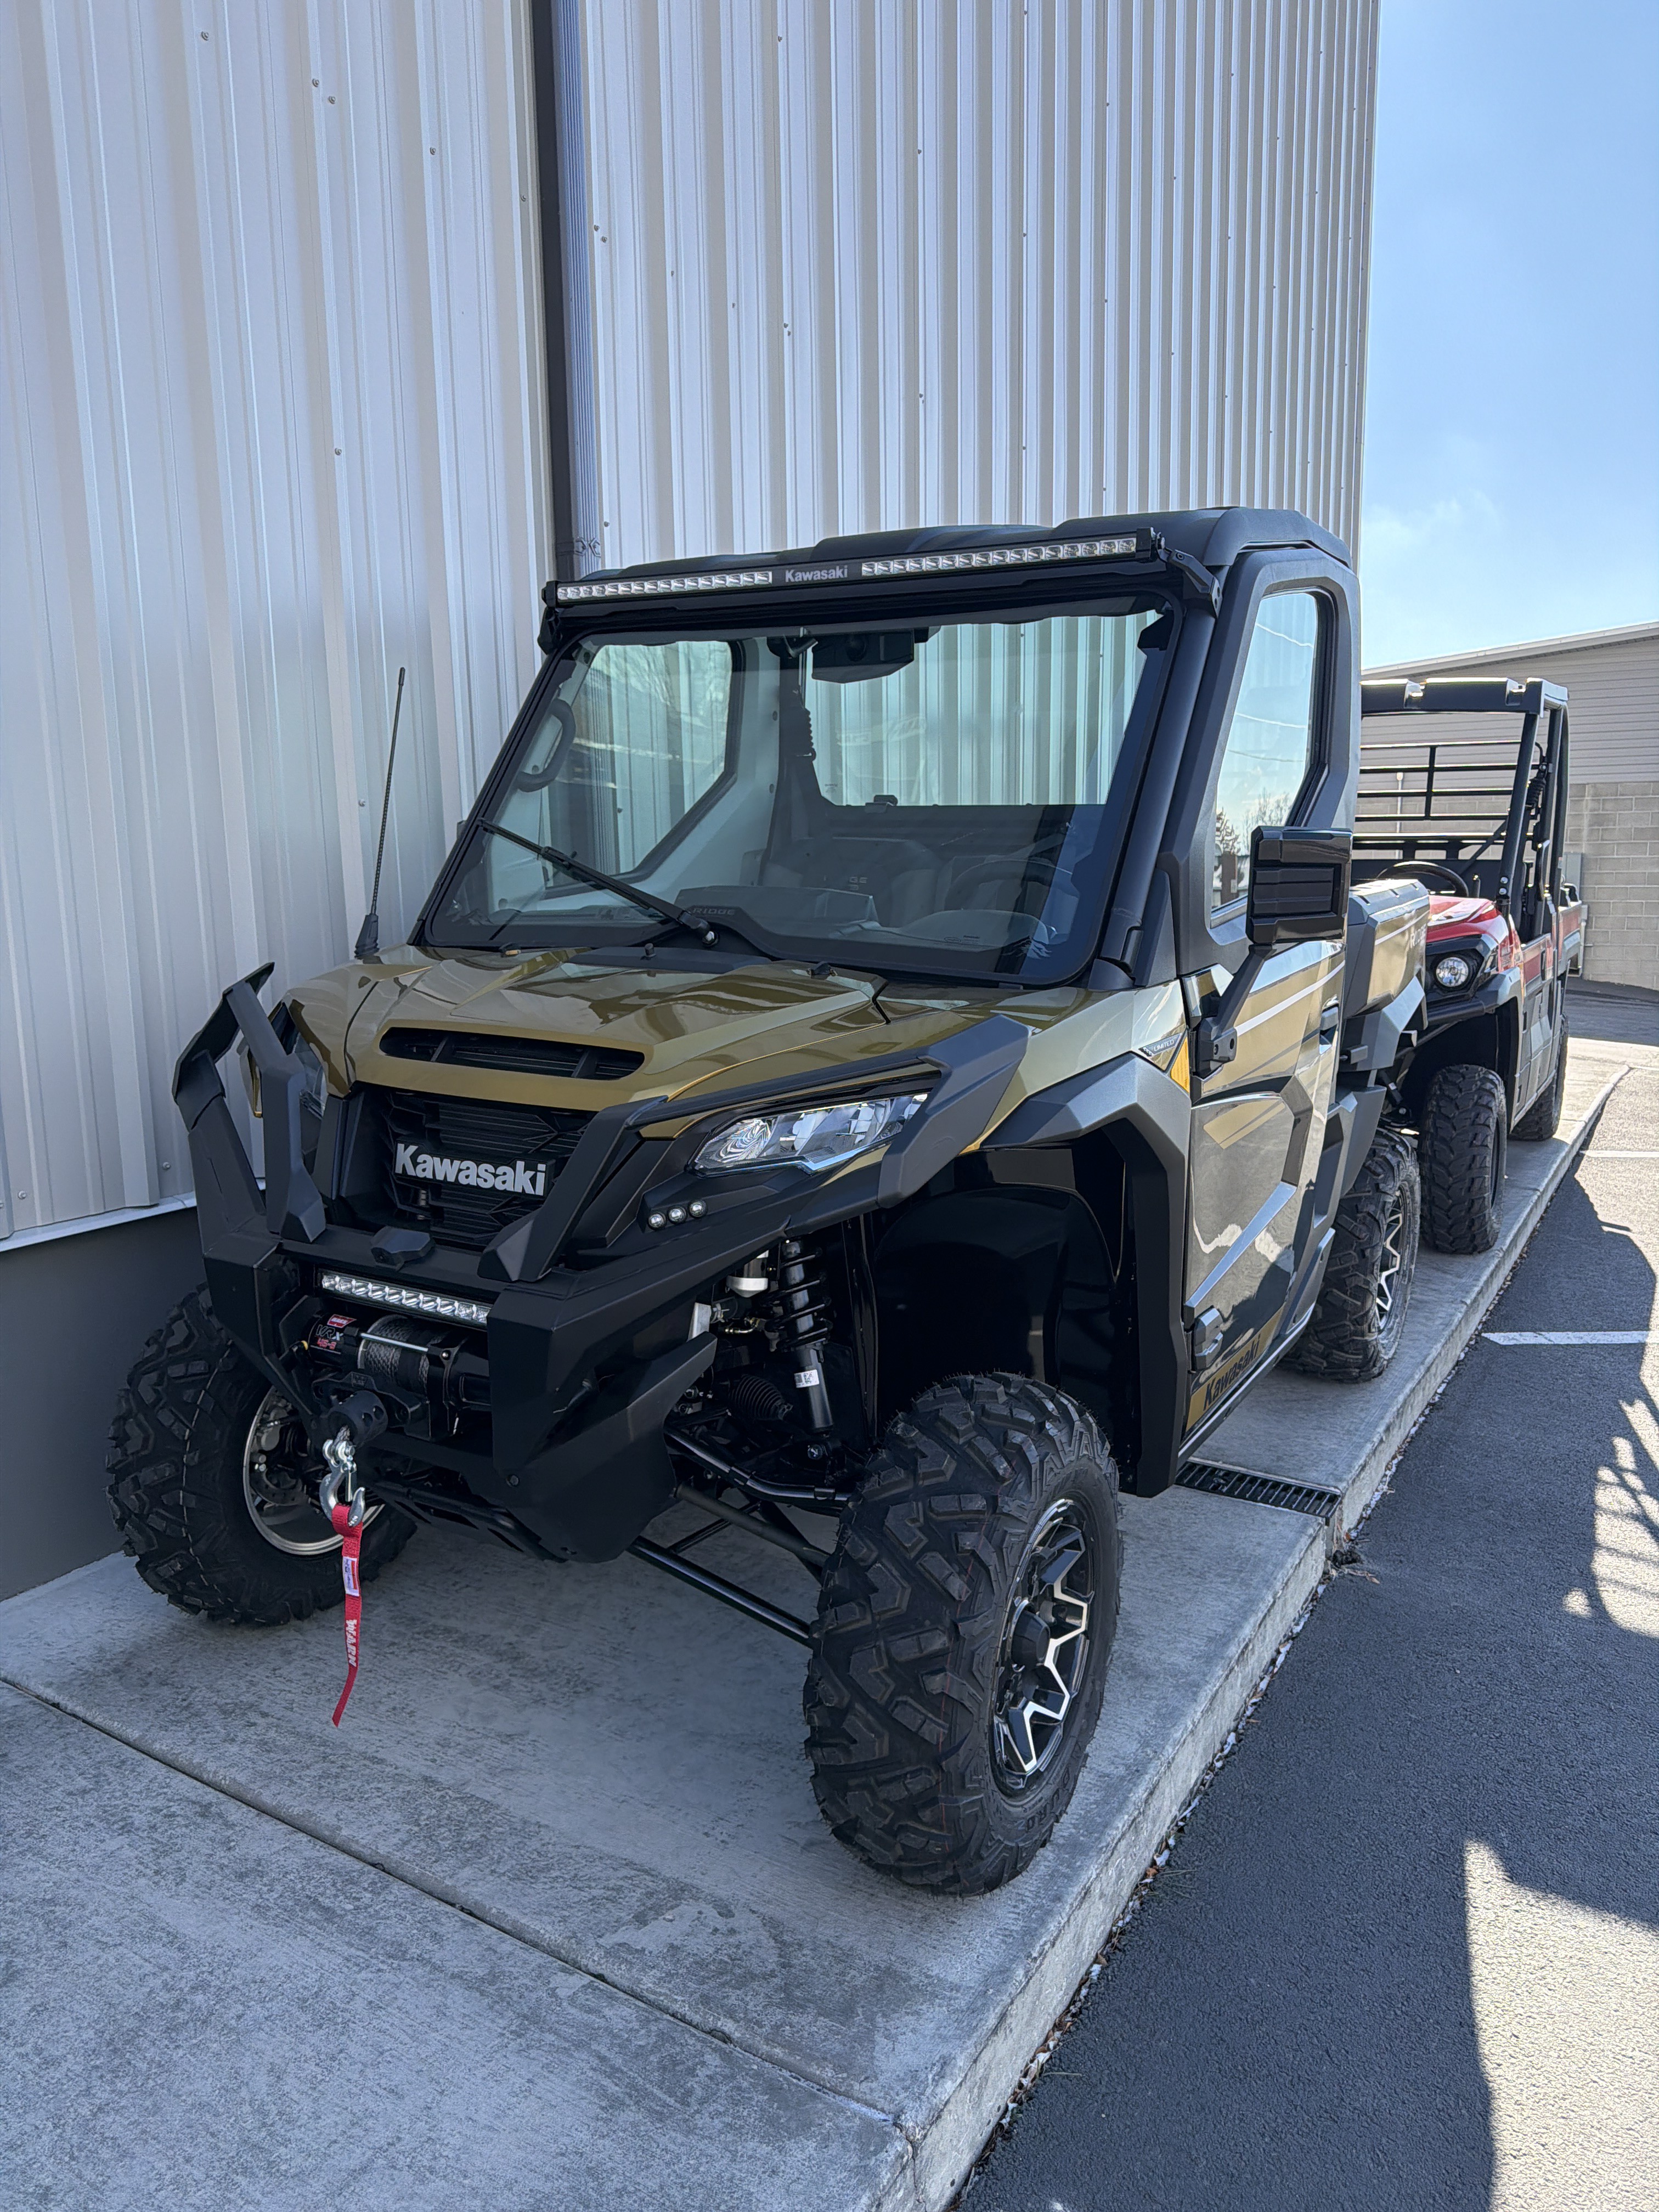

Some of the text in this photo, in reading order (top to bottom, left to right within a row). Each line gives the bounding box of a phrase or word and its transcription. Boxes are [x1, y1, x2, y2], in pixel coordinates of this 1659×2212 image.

[785, 565, 848, 583] Kawasaki
[1153, 1039, 1175, 1052] LIMITED
[394, 1143, 547, 1196] Kawasaki
[1203, 1333, 1261, 1411] Kawasaki
[345, 1619, 357, 1667] WARN
